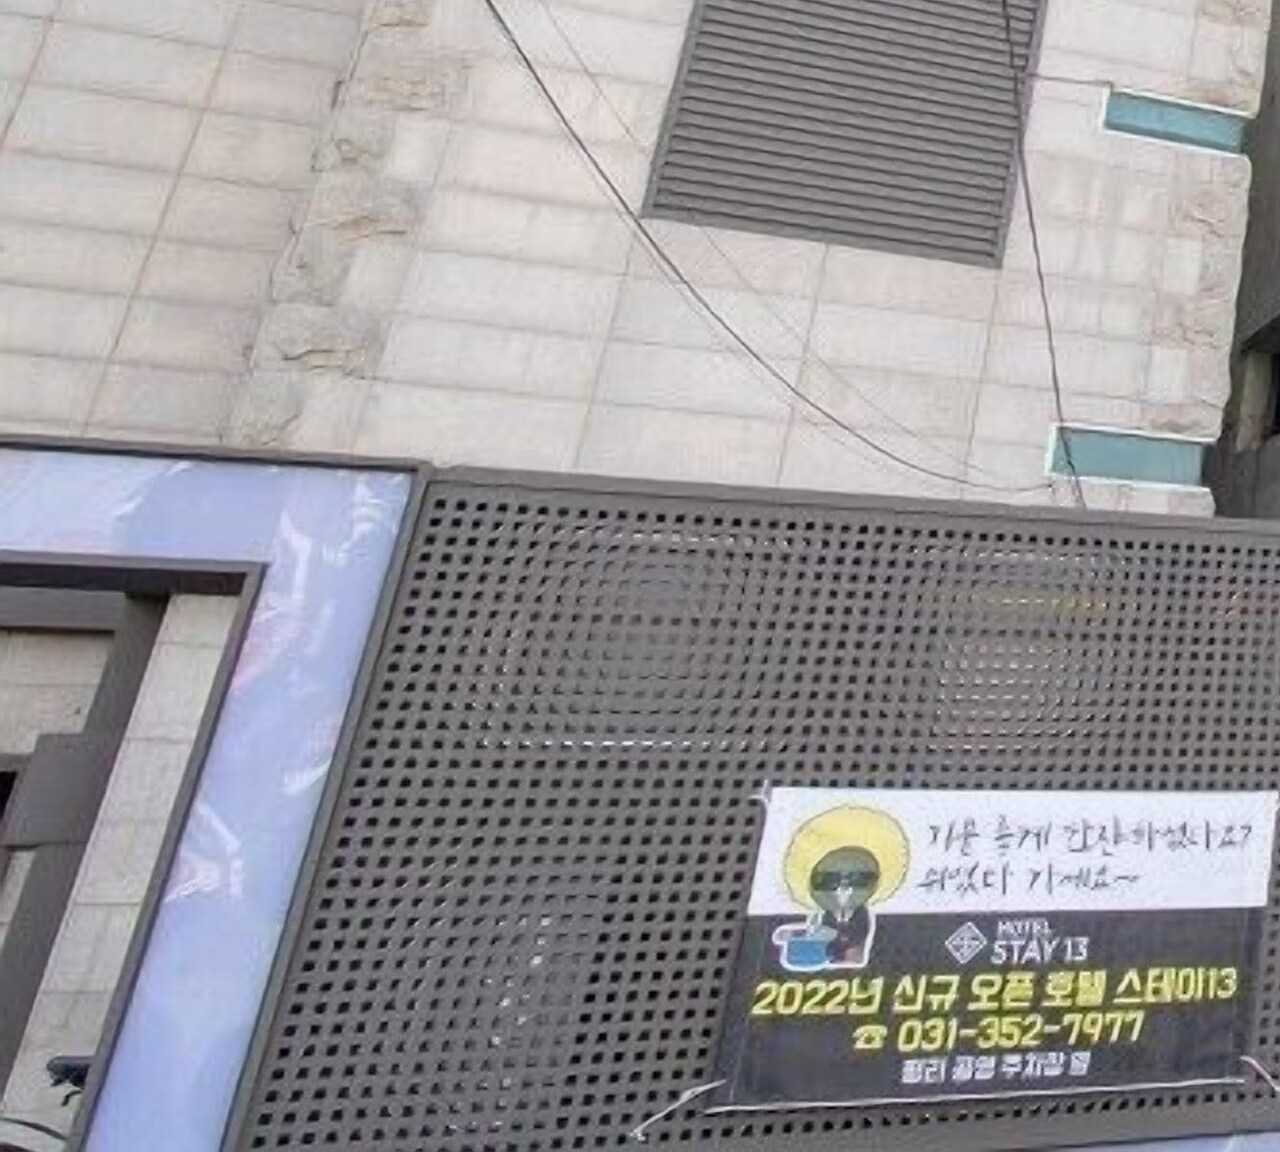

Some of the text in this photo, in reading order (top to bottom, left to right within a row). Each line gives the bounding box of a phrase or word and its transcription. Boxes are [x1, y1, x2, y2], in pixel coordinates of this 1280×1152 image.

[990, 936, 1090, 965] STAY 13
[751, 966, 1239, 1015] 2022년 신규 오픈 호텔 스테이13
[898, 1010, 1146, 1053] 031-352-7977
